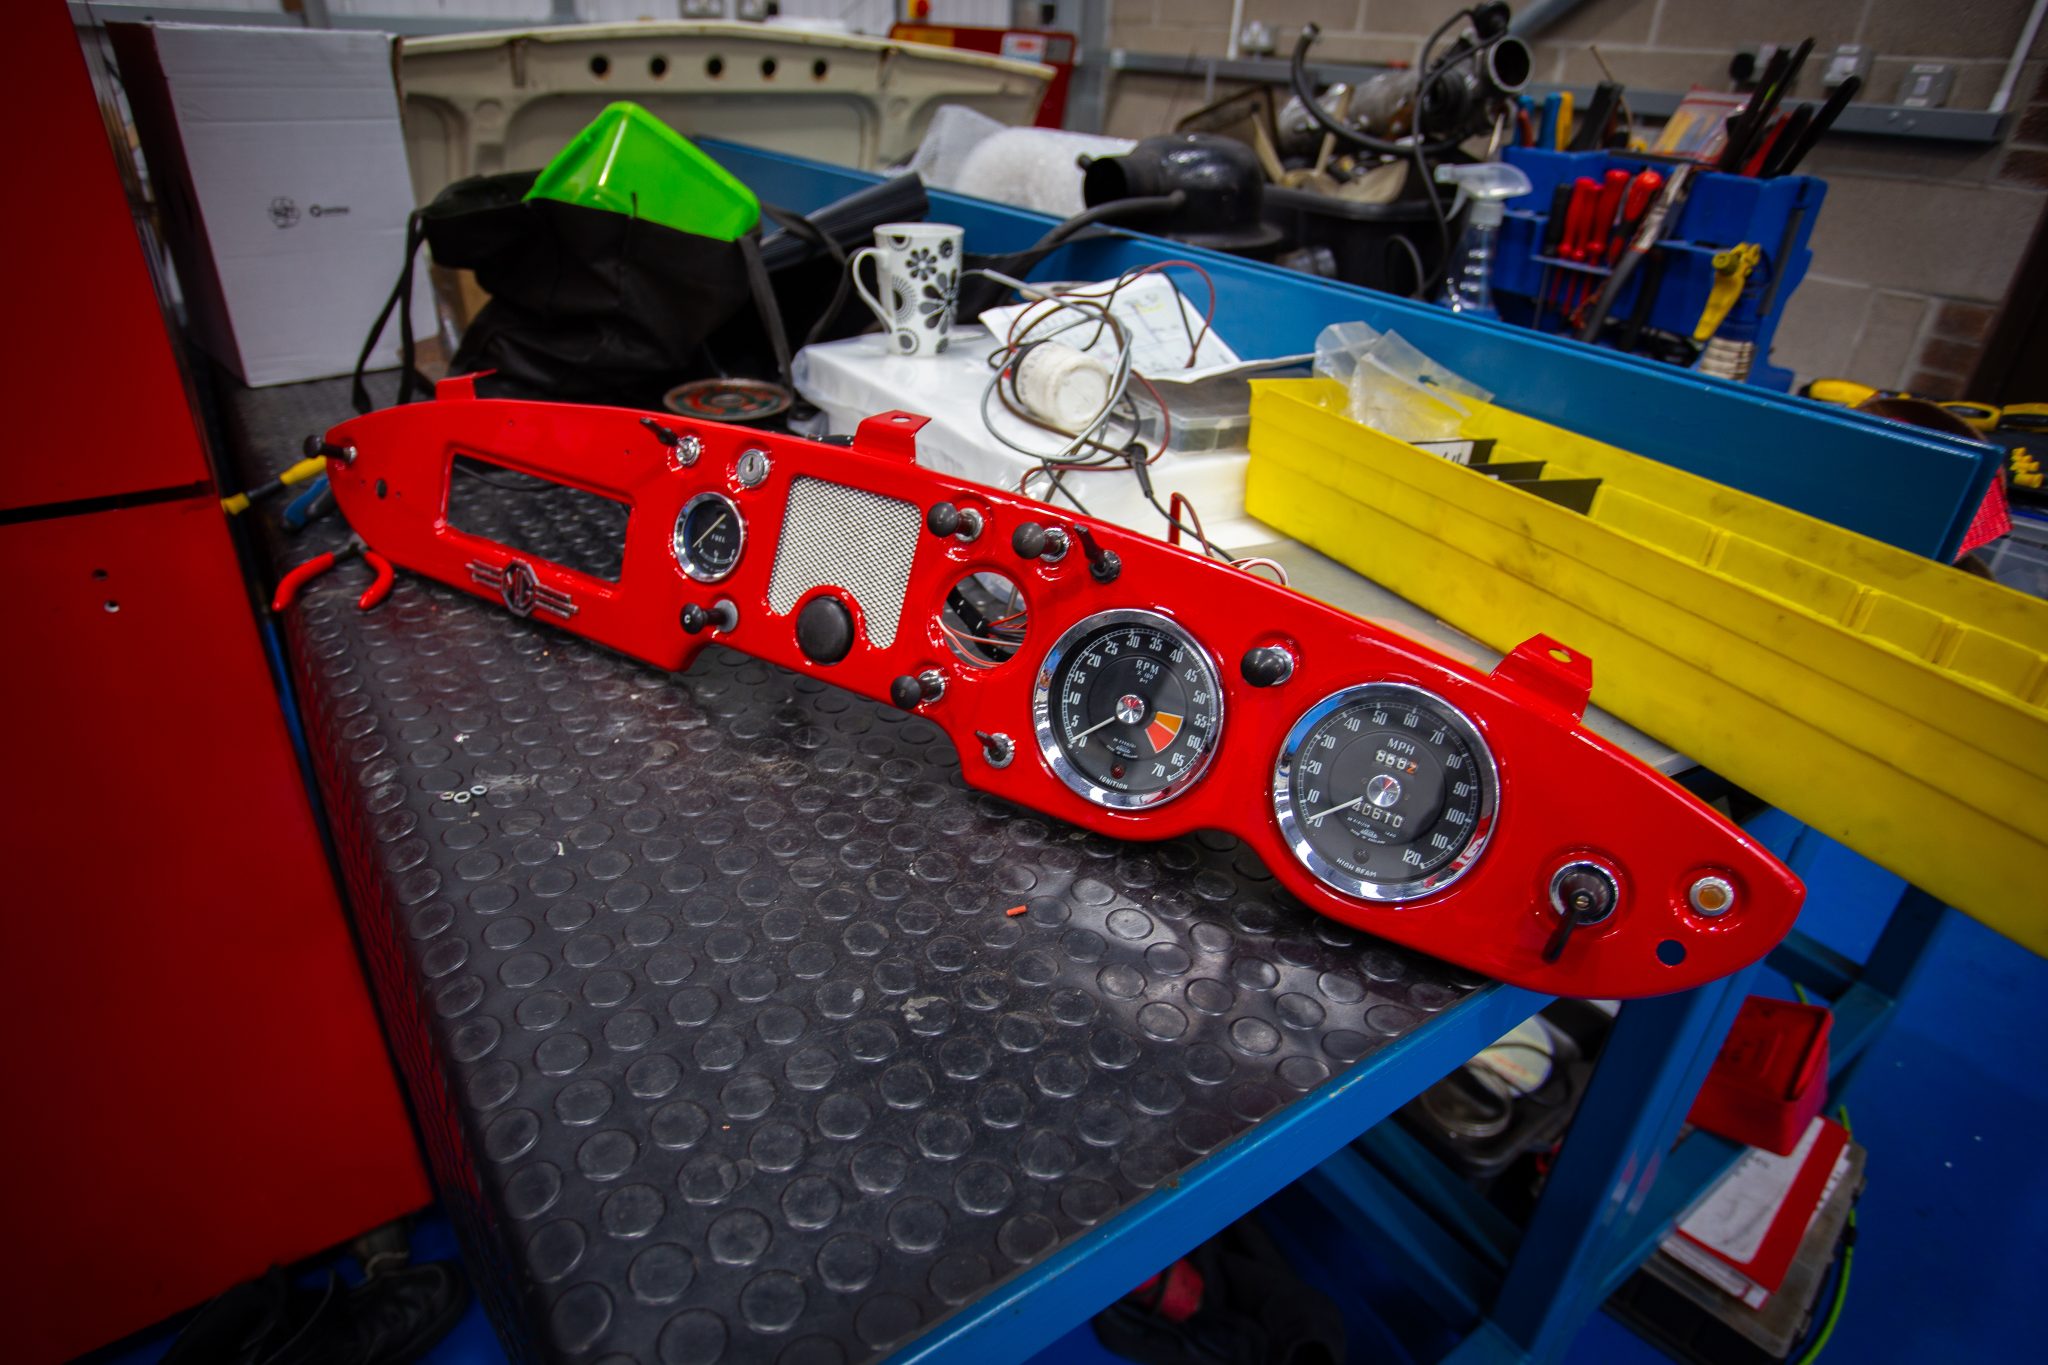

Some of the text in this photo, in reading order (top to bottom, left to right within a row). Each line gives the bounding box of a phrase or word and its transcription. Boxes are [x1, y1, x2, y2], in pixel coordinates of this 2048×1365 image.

[1105, 641, 1119, 655] 25
[1126, 634, 1141, 649] 30
[1149, 637, 1163, 651] 35
[1086, 653, 1102, 668] 20
[1169, 649, 1184, 664] 40
[1135, 659, 1160, 675] RPM
[1073, 671, 1087, 684] 15
[1184, 668, 1198, 683] 45
[1069, 691, 1081, 705] 10
[1192, 690, 1206, 704] 50
[1071, 715, 1080, 727] 5
[1193, 713, 1208, 728] 55
[1343, 717, 1360, 732] 40
[1372, 710, 1388, 725] 50
[1403, 712, 1419, 728] 60
[1078, 736, 1087, 748] 0
[1186, 734, 1201, 749] 60
[1320, 735, 1336, 750] 30
[1429, 730, 1444, 745] 70
[1387, 737, 1415, 755] MPH
[1171, 752, 1185, 767] 65
[1446, 754, 1462, 770] 80
[1152, 763, 1165, 777] 70
[1306, 760, 1322, 775] 20
[1099, 775, 1129, 790] IGNITION
[1453, 782, 1469, 797] 90
[1307, 789, 1320, 804] 10
[1445, 808, 1466, 825] 100
[1431, 833, 1448, 849] 110
[1402, 849, 1421, 866] 120
[1336, 857, 1377, 878] HIGH BEAM
